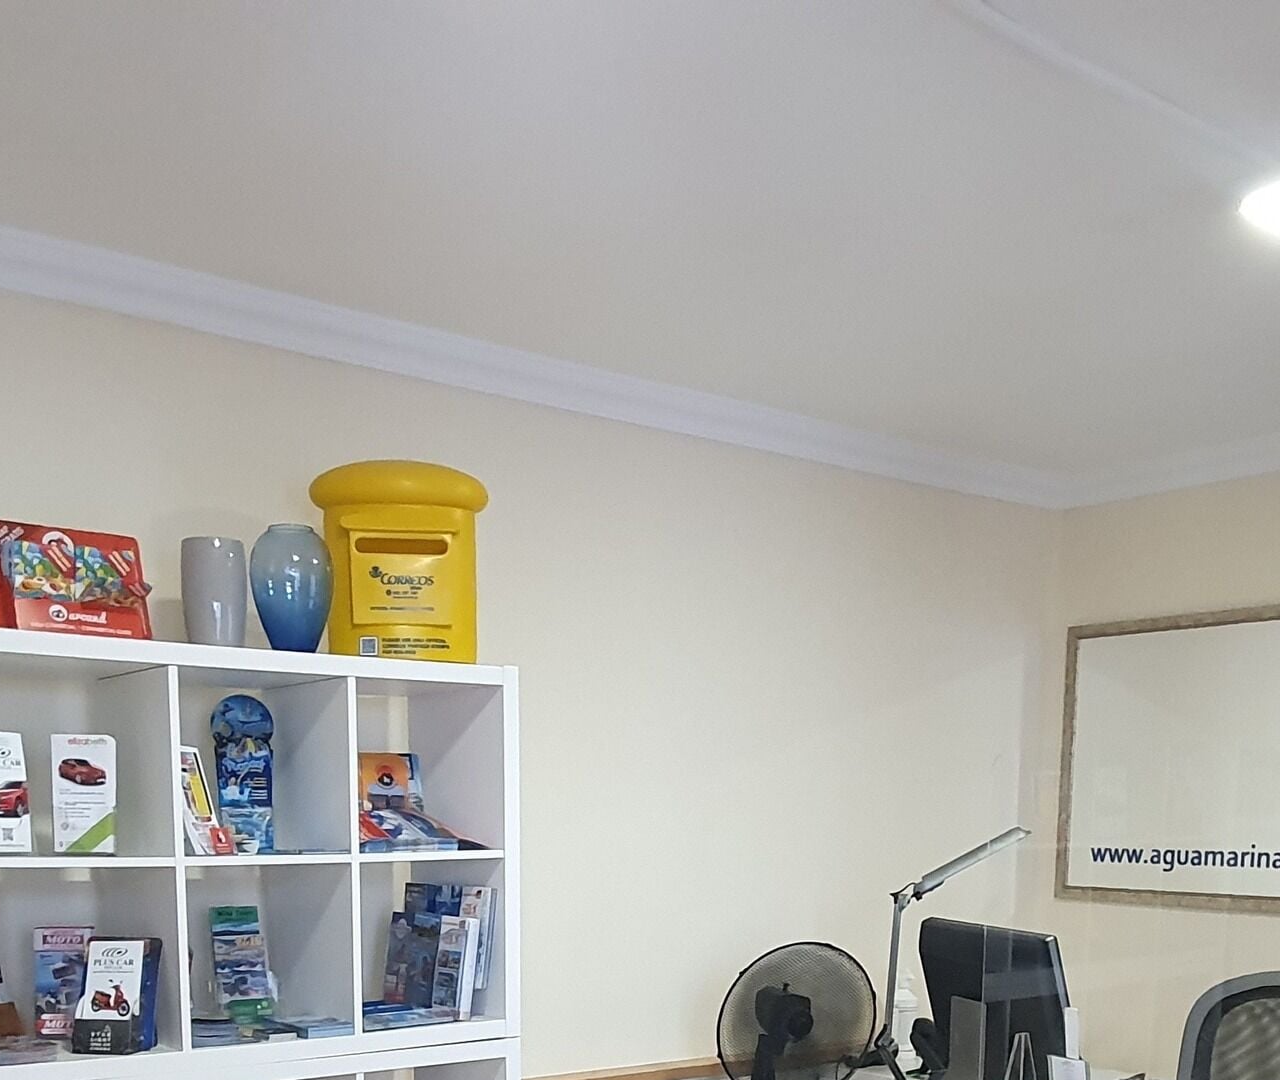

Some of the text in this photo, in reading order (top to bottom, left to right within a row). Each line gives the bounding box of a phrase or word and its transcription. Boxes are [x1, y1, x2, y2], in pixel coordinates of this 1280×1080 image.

[46, 935, 81, 945] MOTO
[93, 958, 134, 967] PLUS CAR
[43, 1019, 74, 1029] MOT
